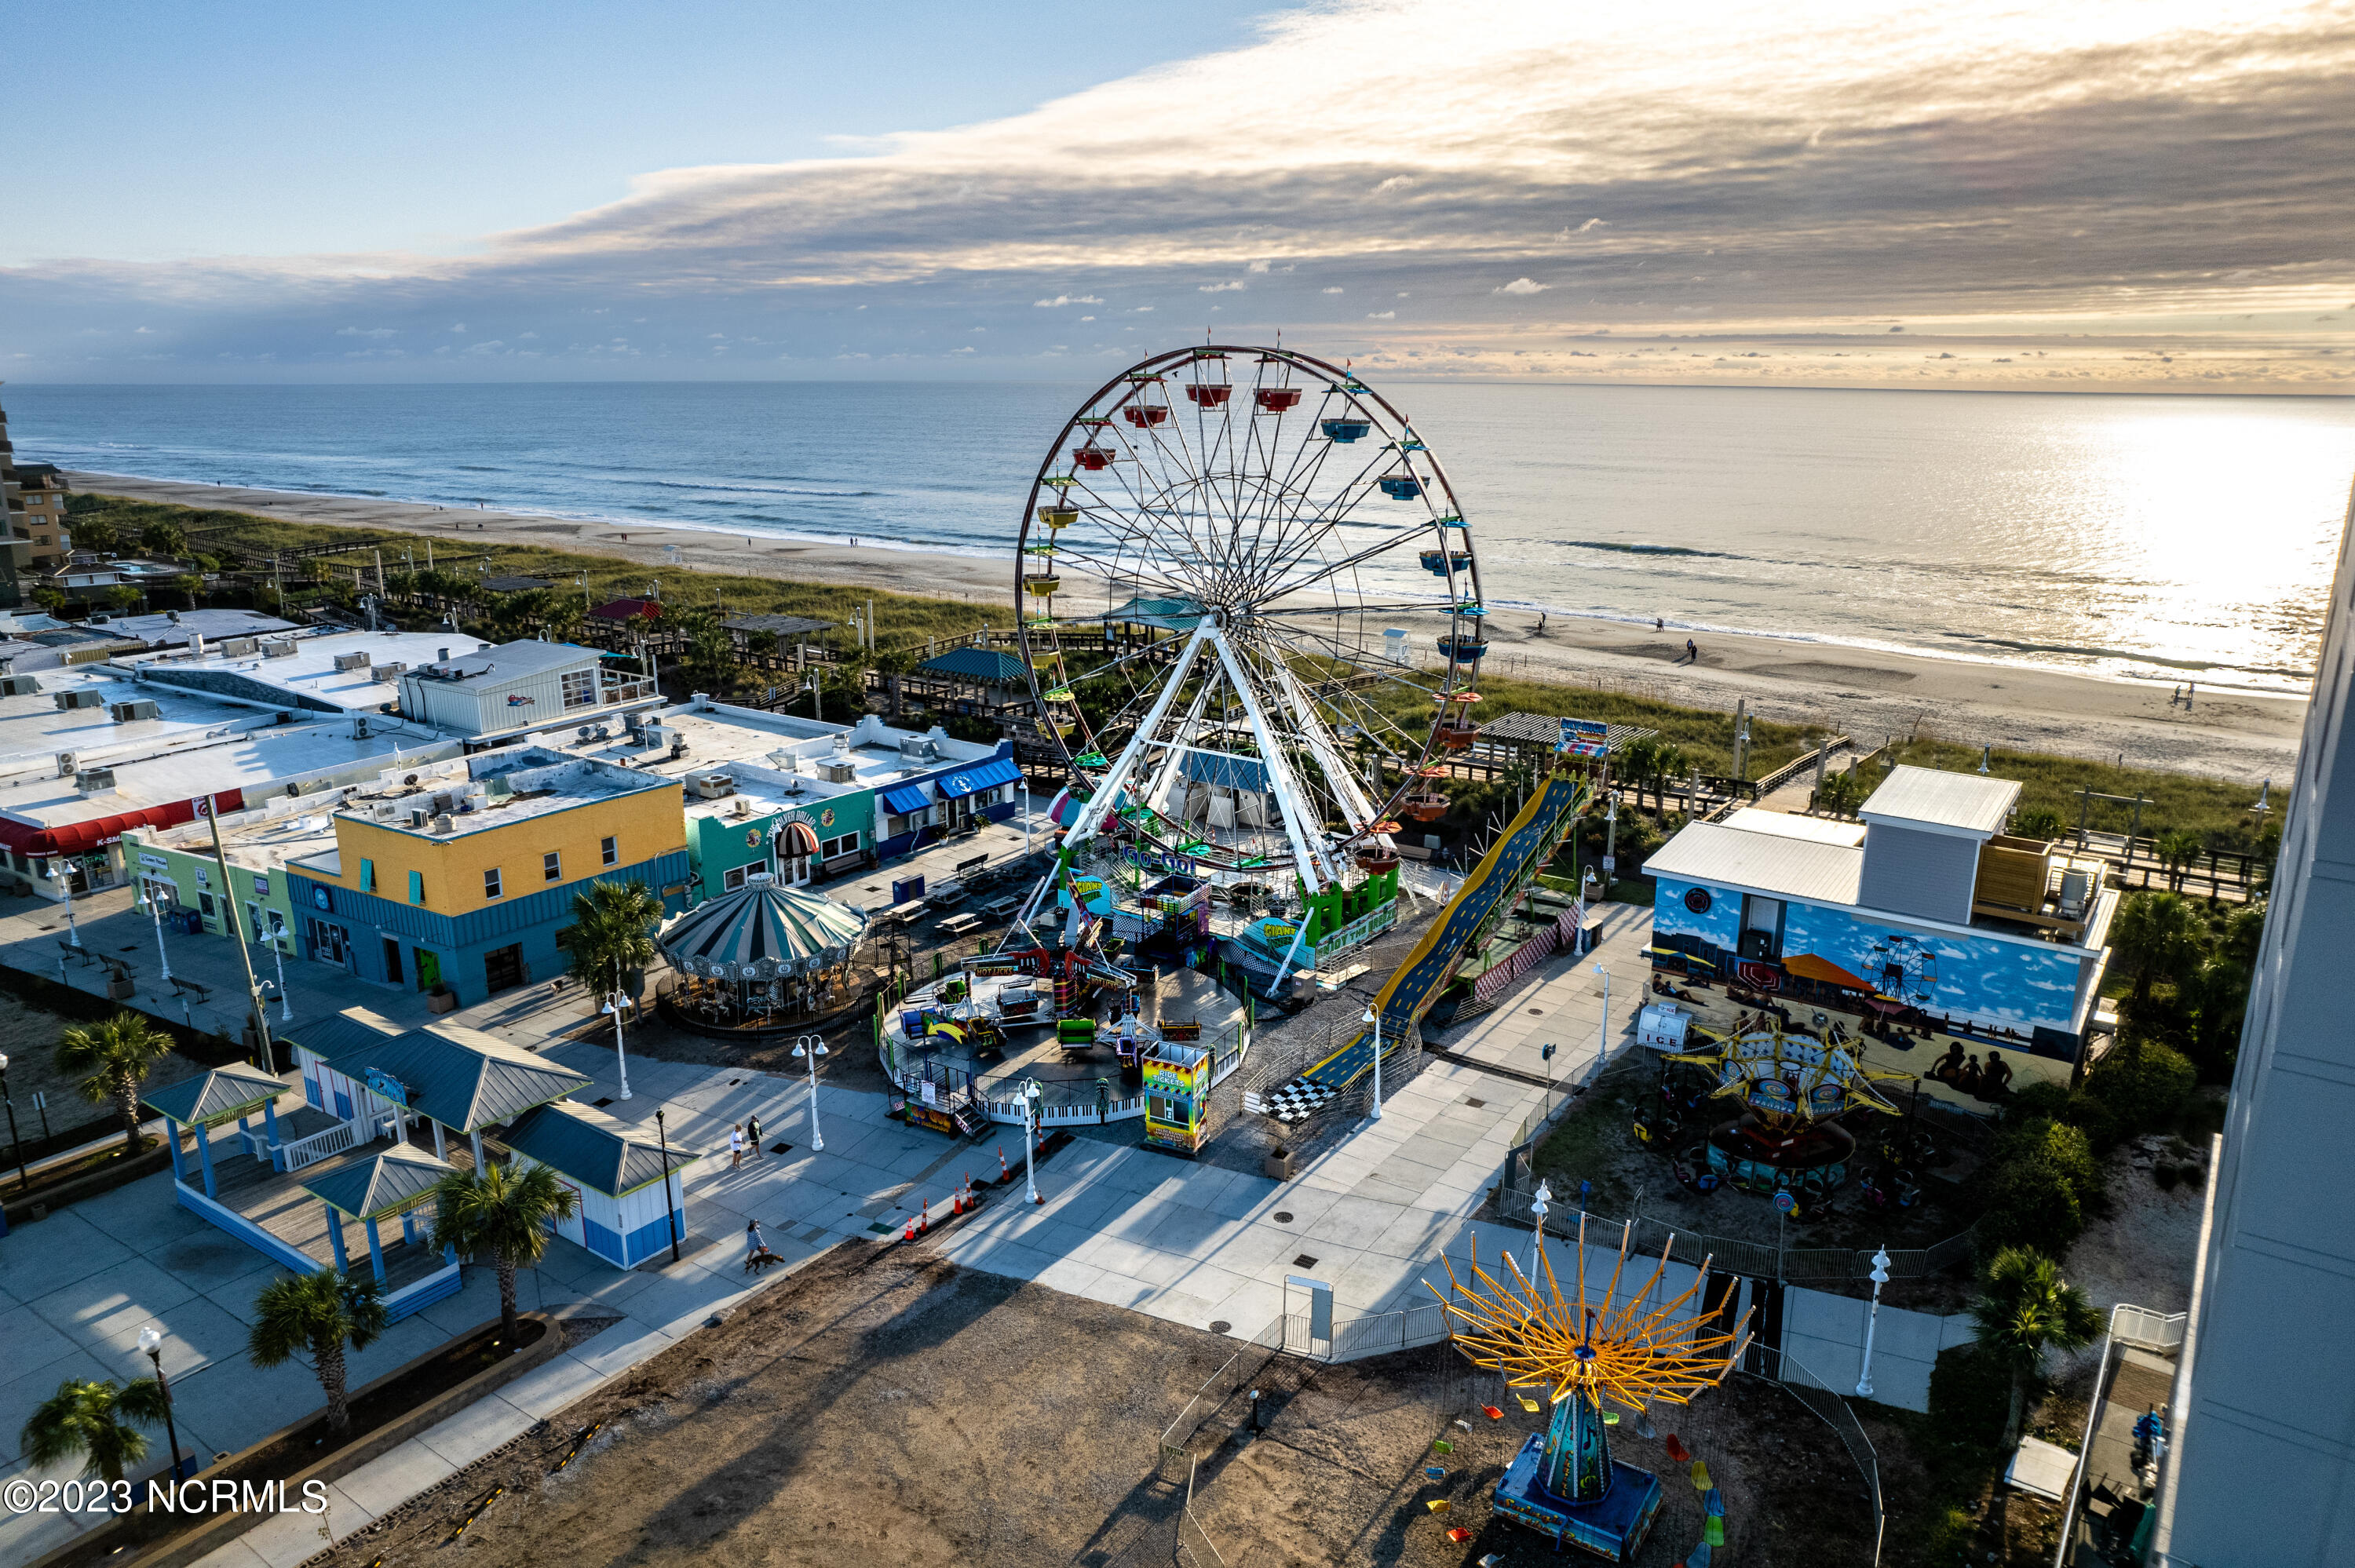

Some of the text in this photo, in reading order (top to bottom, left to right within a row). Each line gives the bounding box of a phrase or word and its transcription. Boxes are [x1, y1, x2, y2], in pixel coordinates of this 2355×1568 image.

[776, 811, 795, 829] SILVER
[795, 810, 816, 828] DOLLAR
[1076, 880, 1102, 894] GIANT
[1264, 923, 1296, 937] GIANT
[1349, 925, 1367, 941] THE
[992, 967, 1013, 975] LICKS
[1090, 976, 1102, 986] HOT
[1646, 1034, 1677, 1048] ICE
[1152, 1074, 1185, 1087] TICKETS
[1159, 1070, 1178, 1079] RIDE
[955, 1118, 969, 1134] EXIT
